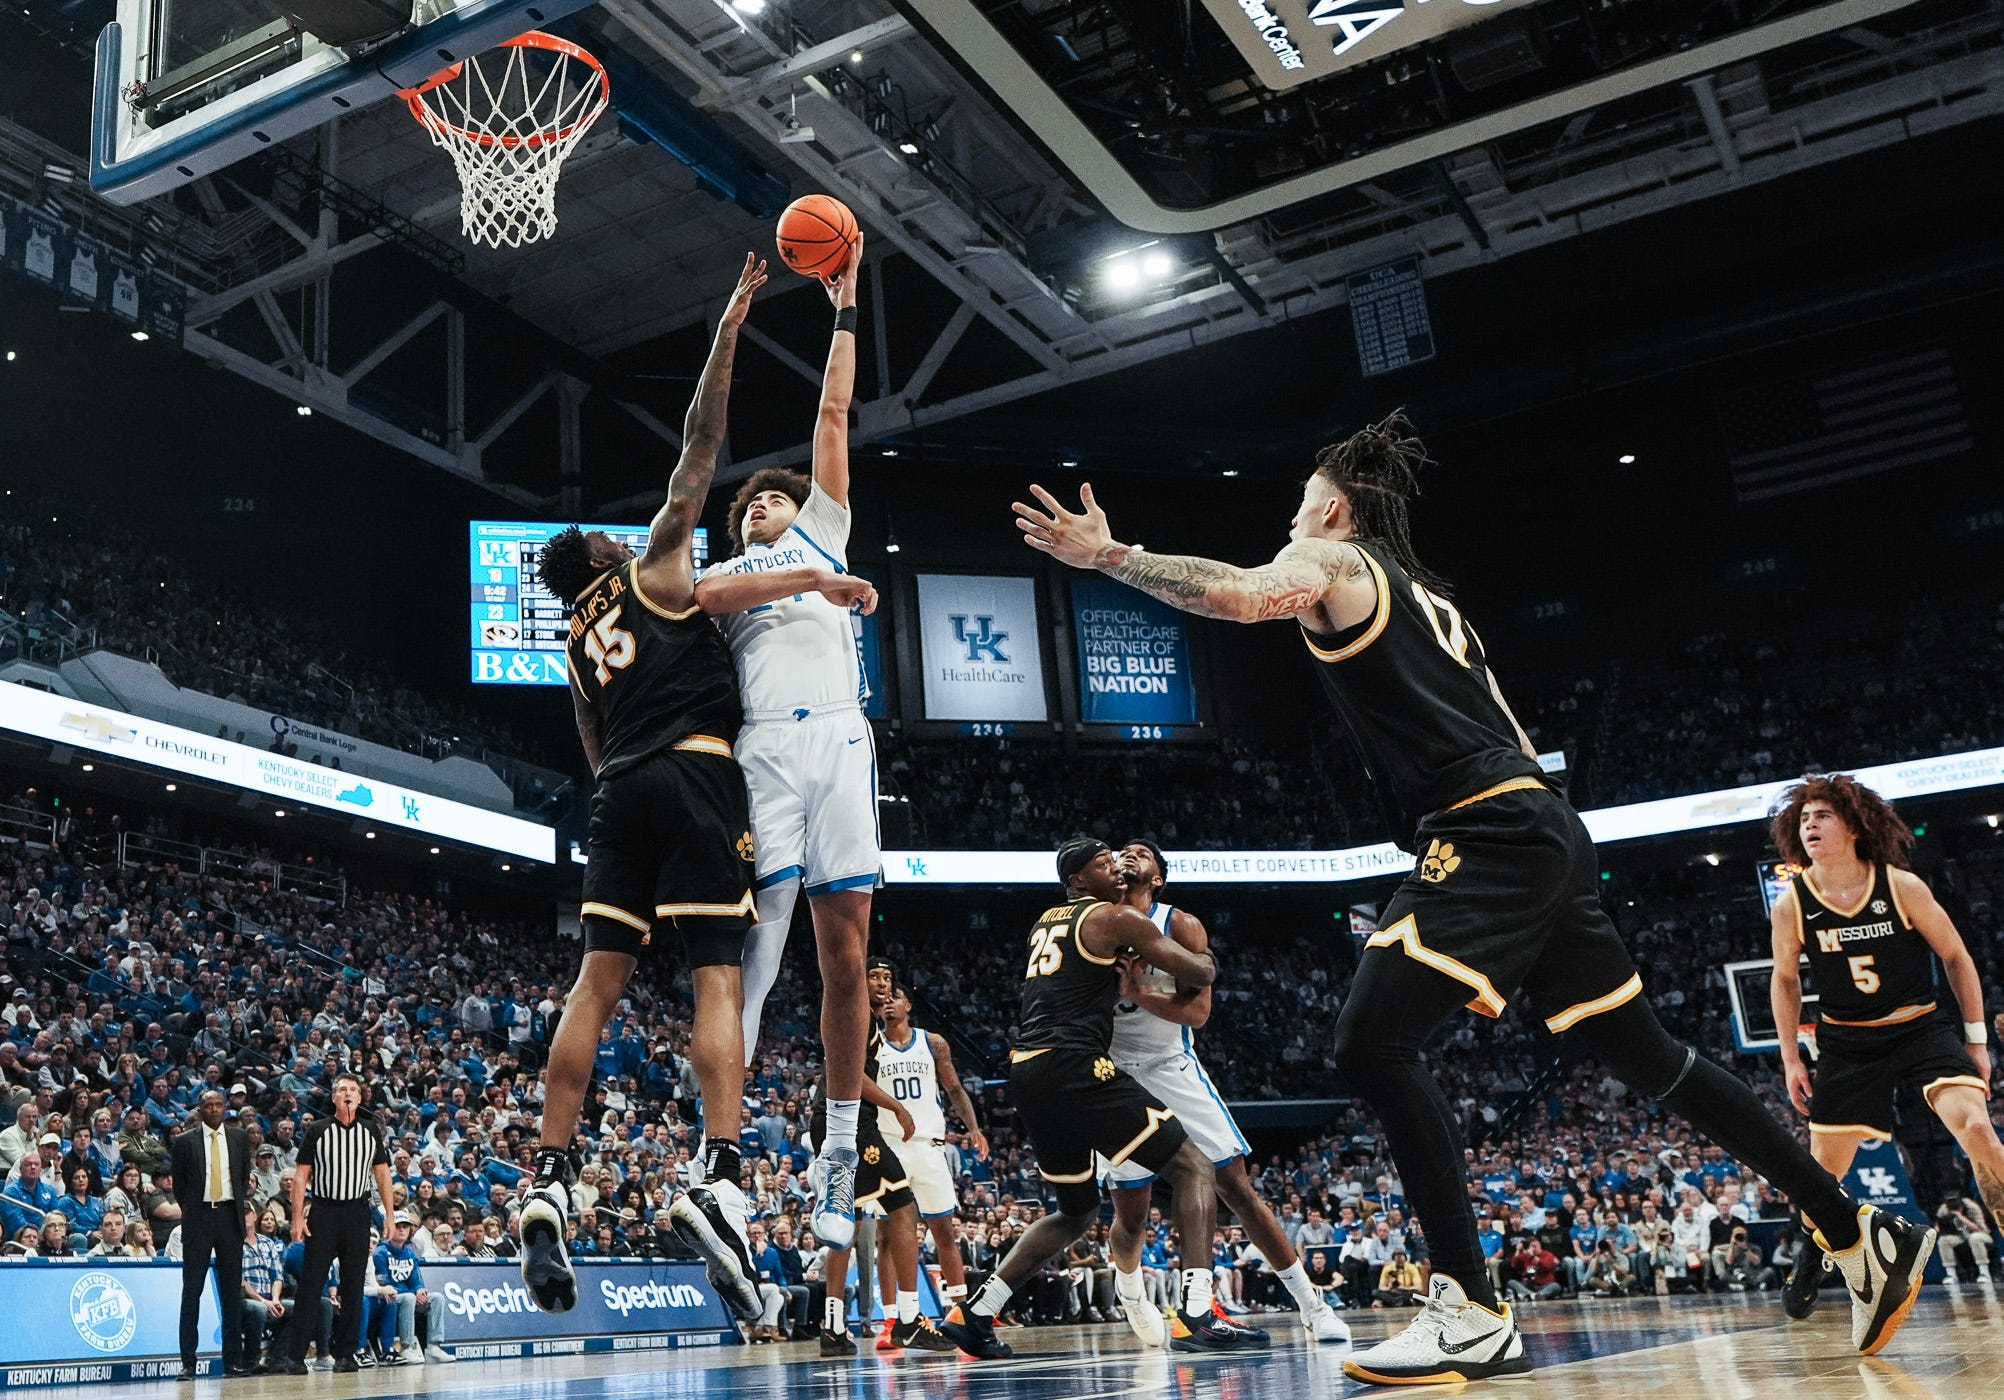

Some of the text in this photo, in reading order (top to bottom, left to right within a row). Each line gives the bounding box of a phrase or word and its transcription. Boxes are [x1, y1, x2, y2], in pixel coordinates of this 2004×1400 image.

[1262, 26, 1305, 70] Center
[485, 543, 512, 563] UK
[731, 549, 806, 576] ENTUCKY
[488, 568, 502, 583] 19
[488, 604, 503, 620] 23
[570, 575, 627, 640] HILLIPS JR.
[1081, 609, 1148, 624] OFFICIAL
[523, 630, 531, 639] 17
[949, 614, 1011, 664] UK
[1083, 625, 1180, 640] HEALTHCARE
[584, 603, 636, 687] 15
[1085, 640, 1175, 655] PARTNER OF
[942, 668, 1025, 683] HealthCare
[1087, 656, 1177, 674] BIG BLUE
[1088, 676, 1168, 694] NATION
[291, 724, 318, 742] Central
[319, 733, 339, 746] Bank
[972, 723, 1003, 736] 236
[1131, 726, 1162, 739] 236
[145, 735, 229, 766] CHEVROLET
[258, 759, 338, 788] KENTUCKY SELECT
[263, 773, 333, 799] CHEVY DEALERS
[402, 796, 420, 822] UK
[906, 858, 927, 876] UK
[1167, 859, 1250, 873] HEVROLET
[1256, 859, 1338, 873] CORVETTE
[1816, 920, 1895, 953] MISSOURI
[1025, 924, 1069, 980] 25
[1847, 954, 1881, 995] 5
[880, 1061, 930, 1078] KENTUCKY
[893, 1076, 922, 1101] 00
[1857, 1166, 1899, 1196] UK
[74, 1275, 120, 1299] KENTUCKY
[600, 1280, 704, 1317] Spectrum
[90, 1300, 119, 1325] KFB
[443, 1281, 539, 1322] Spectru
[79, 1318, 135, 1349] FARM BUREAU
[7, 1365, 112, 1386] KENTUCKY FARM BUREAU
[130, 1361, 210, 1378] BIG ON COMMENT
